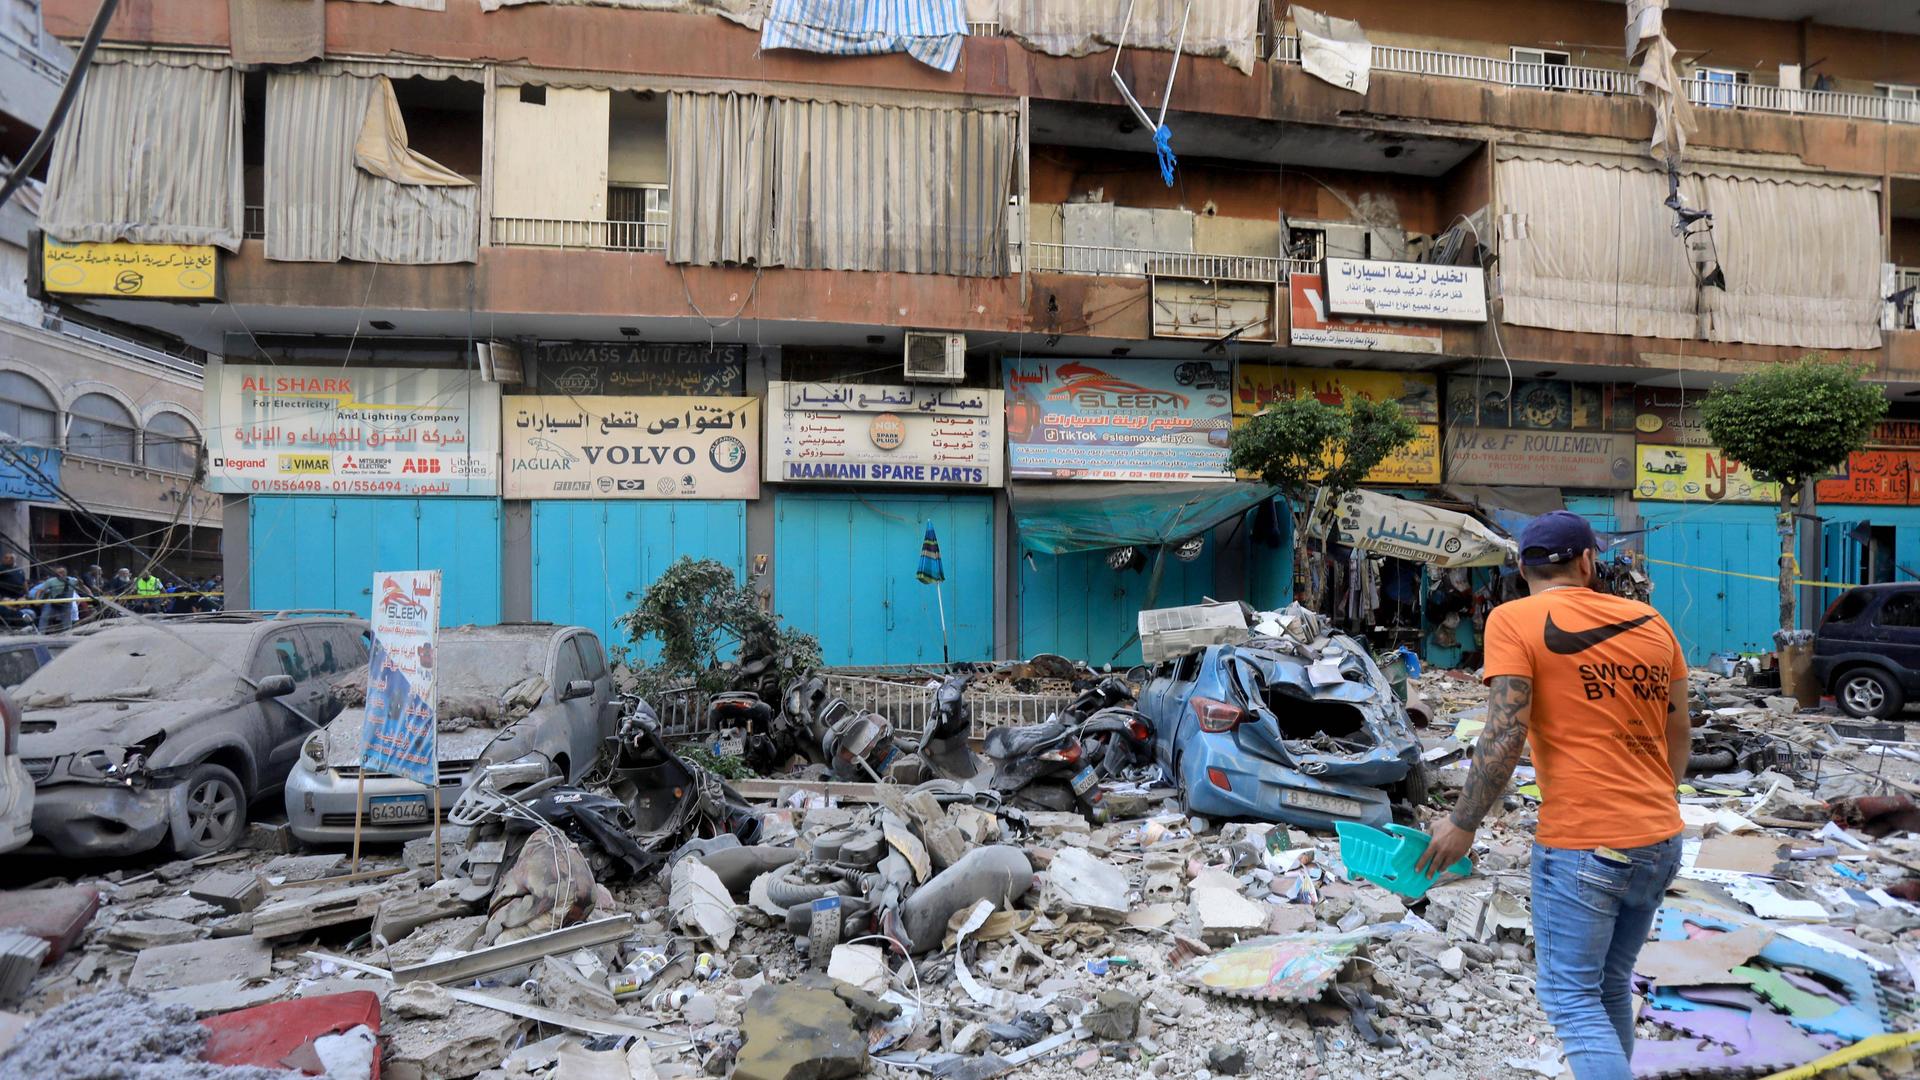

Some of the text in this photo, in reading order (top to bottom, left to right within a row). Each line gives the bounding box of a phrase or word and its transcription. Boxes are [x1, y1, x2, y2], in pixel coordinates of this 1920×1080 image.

[1341, 262, 1468, 286] الخليل لزينة السيارات
[1403, 287, 1424, 296] تركيب
[1326, 325, 1349, 333] MADE
[628, 348, 671, 364] AUTO
[677, 349, 735, 364] PARTS
[241, 377, 352, 393] AL SHARK
[252, 399, 331, 410] For Electricity
[791, 387, 983, 411] نعماني لقطع الغيار
[1079, 395, 1180, 409] SLEEM
[337, 412, 460, 424] And Lighting Company
[516, 411, 589, 433] السيارات
[600, 411, 639, 434] لقطع
[875, 421, 899, 430] NGK
[932, 415, 974, 425] هوندا
[1044, 413, 1194, 431] سليم لزينة السيارات
[799, 424, 845, 433] سوبارو
[930, 428, 974, 438] نيسان
[1059, 430, 1097, 441] TikTok
[1873, 421, 1920, 438] TIMKE
[286, 433, 296, 446] و
[301, 427, 362, 447] للكهرباء
[366, 427, 417, 447] الشرق
[422, 428, 466, 447] شركة
[1502, 434, 1520, 450] F
[1524, 435, 1614, 455] ROULEMENT
[225, 457, 267, 470] legrand
[294, 458, 330, 470] VIMAR
[402, 458, 441, 474] ABB
[450, 457, 480, 467] Liban
[512, 446, 697, 471] JAGUAR VOLVO
[790, 463, 983, 483] NAAMANI SPARE PARTS
[251, 479, 451, 495] تليفون 01/556494 01/556498
[553, 481, 592, 491] FIAT
[1855, 478, 1878, 493] ETS.
[1881, 478, 1906, 493] FILS
[1367, 515, 1446, 549] الخليل
[1380, 543, 1416, 557] السيارات
[388, 606, 424, 620] SLEEM
[1584, 682, 1616, 700] BY
[372, 804, 425, 820] G430442
